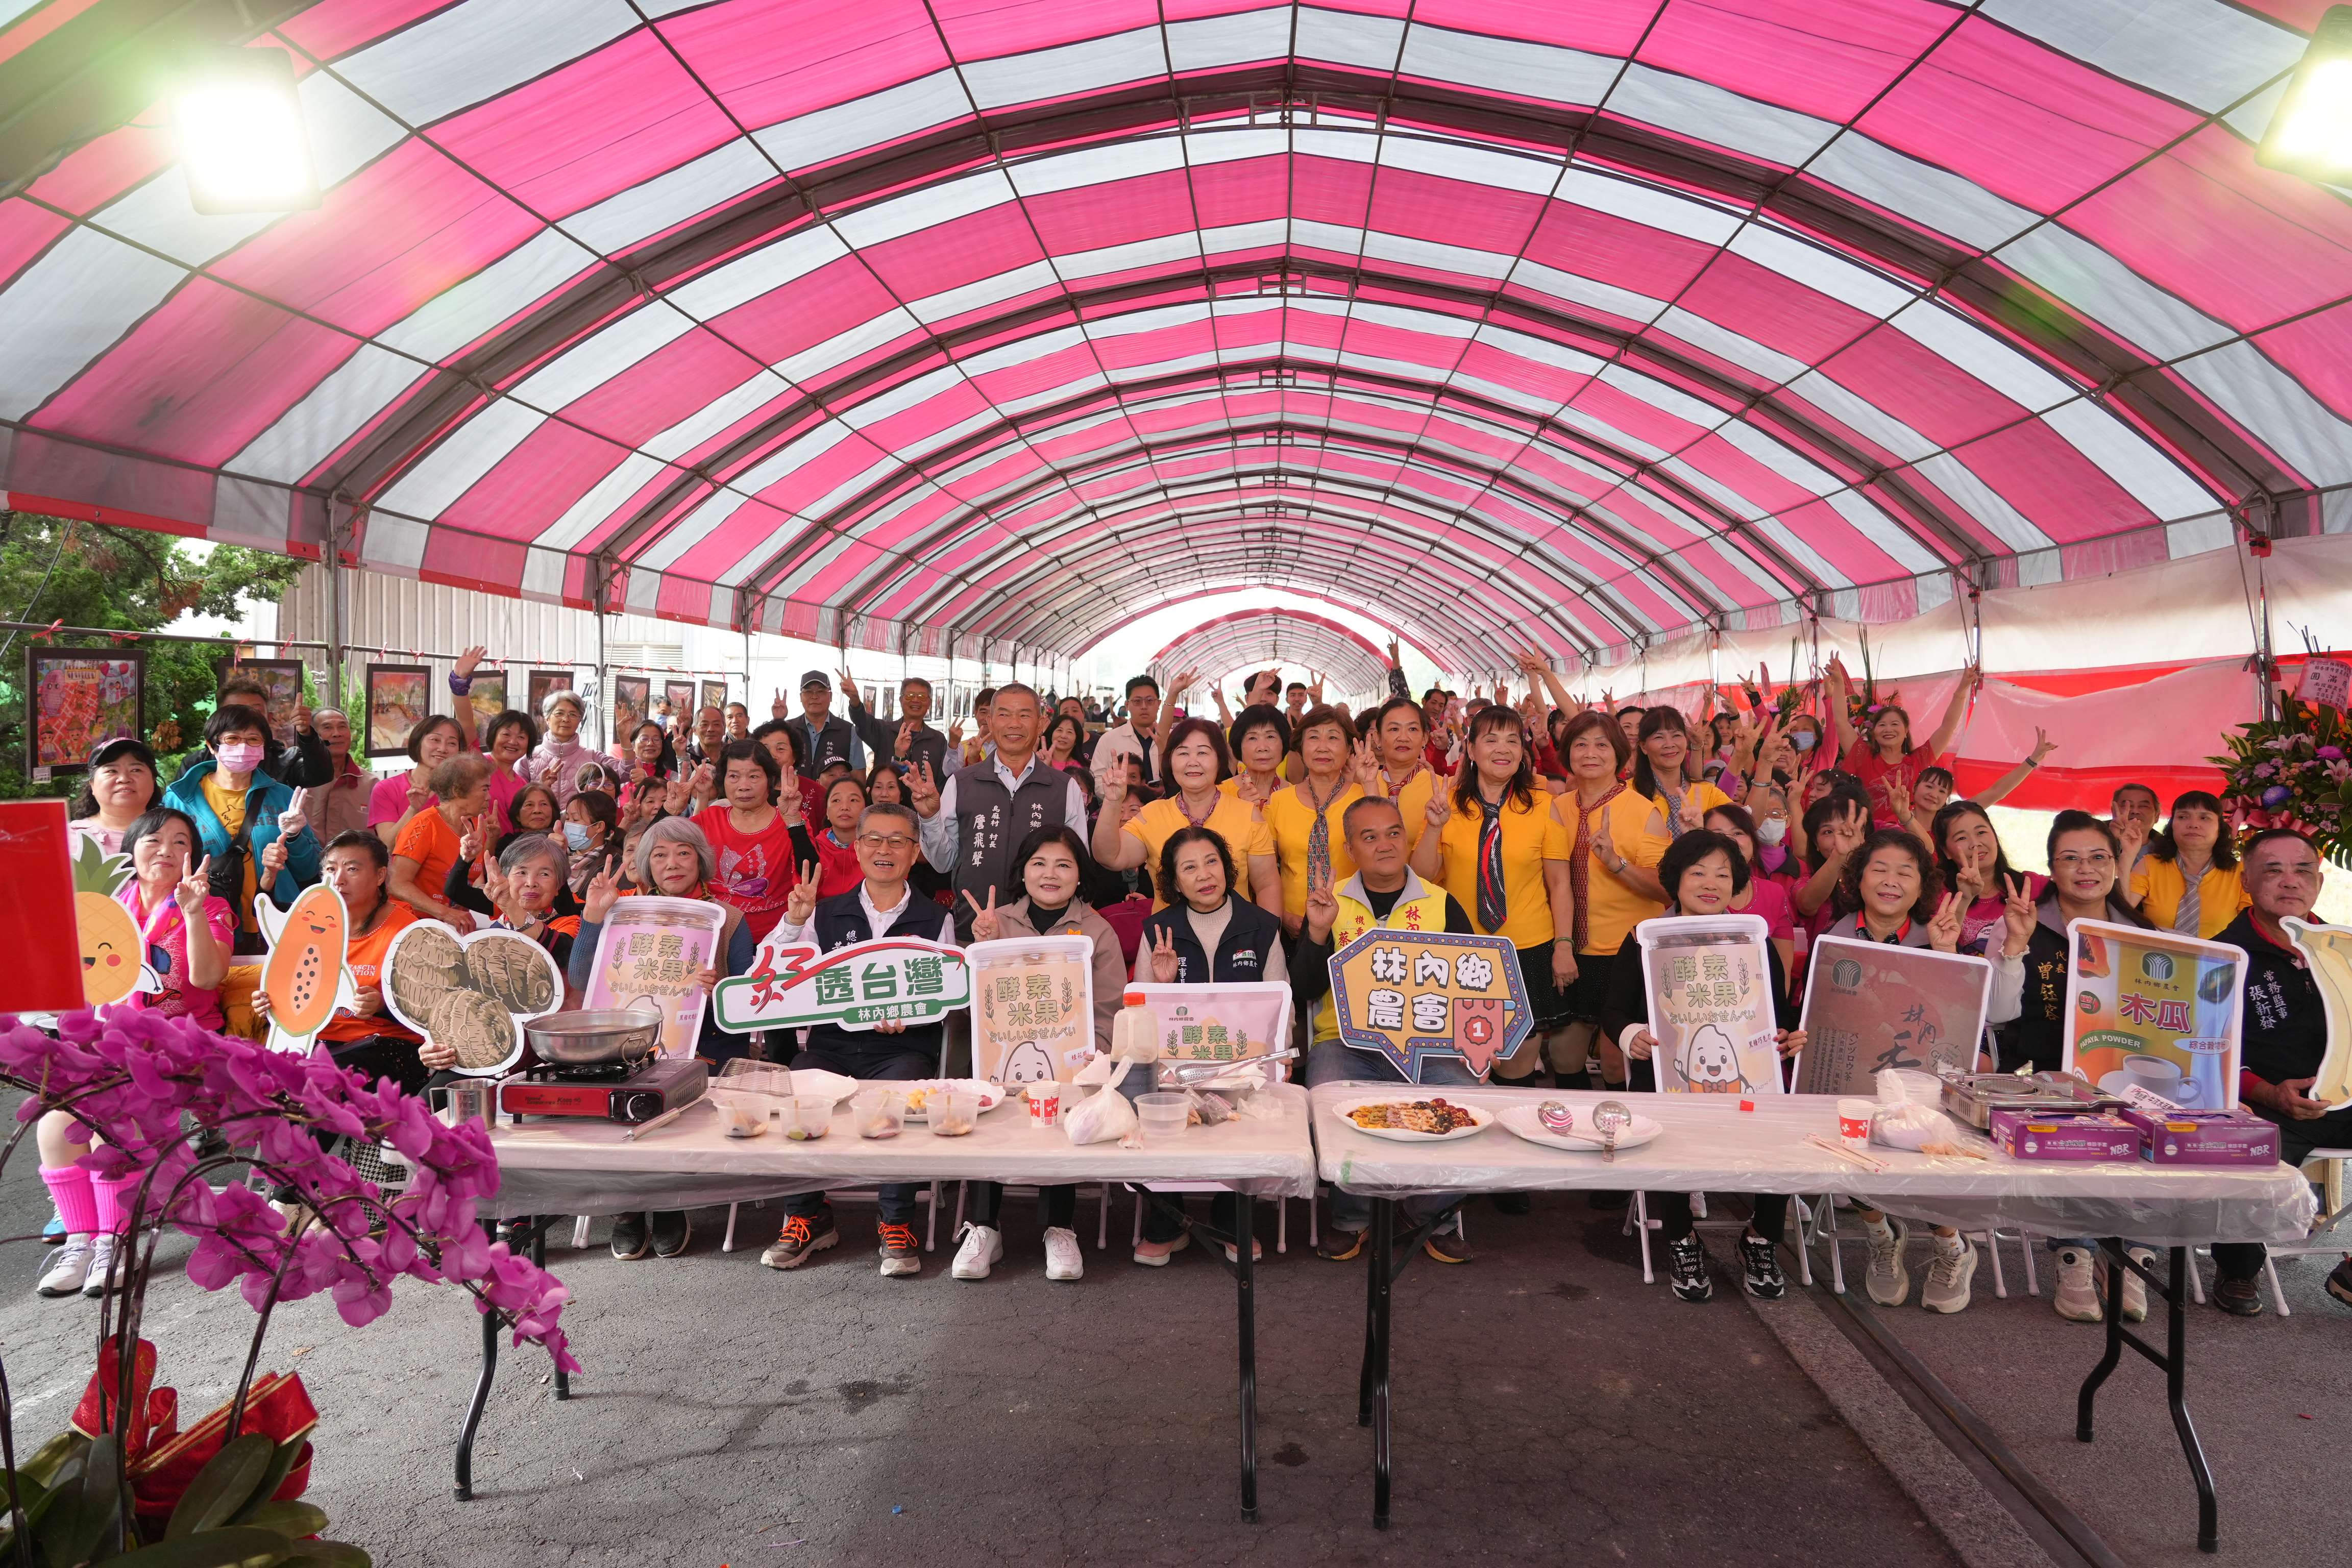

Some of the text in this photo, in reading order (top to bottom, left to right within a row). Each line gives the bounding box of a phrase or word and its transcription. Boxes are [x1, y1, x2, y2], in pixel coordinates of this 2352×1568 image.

[989, 805, 1000, 848] 烏麻村 村長
[1030, 803, 1043, 832] 林內鄉
[972, 814, 987, 867] 詹飛聲
[628, 933, 683, 958] 酵素
[1337, 931, 1352, 947] 蔡
[633, 958, 683, 983] 米果
[1370, 947, 1493, 992] 林內鄉
[1672, 954, 1729, 982] 酵素
[2055, 950, 2067, 973] 代表
[610, 981, 694, 997] おいしいおせんべい
[996, 974, 1051, 1002] 酵素
[1686, 981, 1737, 1008] 米果
[2135, 978, 2180, 992] 林內鄉農會
[2263, 970, 2287, 1019] 常務監事
[858, 1002, 927, 1021] 林內鄉農會
[1008, 999, 1059, 1026] 米果
[1367, 988, 1449, 1033] 農會
[1670, 1010, 1756, 1025] おいしいおせんべい
[2119, 992, 2192, 1034] 木瓜
[2248, 985, 2277, 1030] 張新發
[990, 1026, 1076, 1043] おいしいおせんべい
[1182, 1025, 1228, 1044] 酵素
[1473, 1021, 1485, 1037] 1
[1191, 1045, 1234, 1060] 米果
[2079, 1035, 2141, 1049] PAPAYA POWDER
[2110, 1143, 2130, 1156] NBR
[2250, 1145, 2270, 1156] NBR
